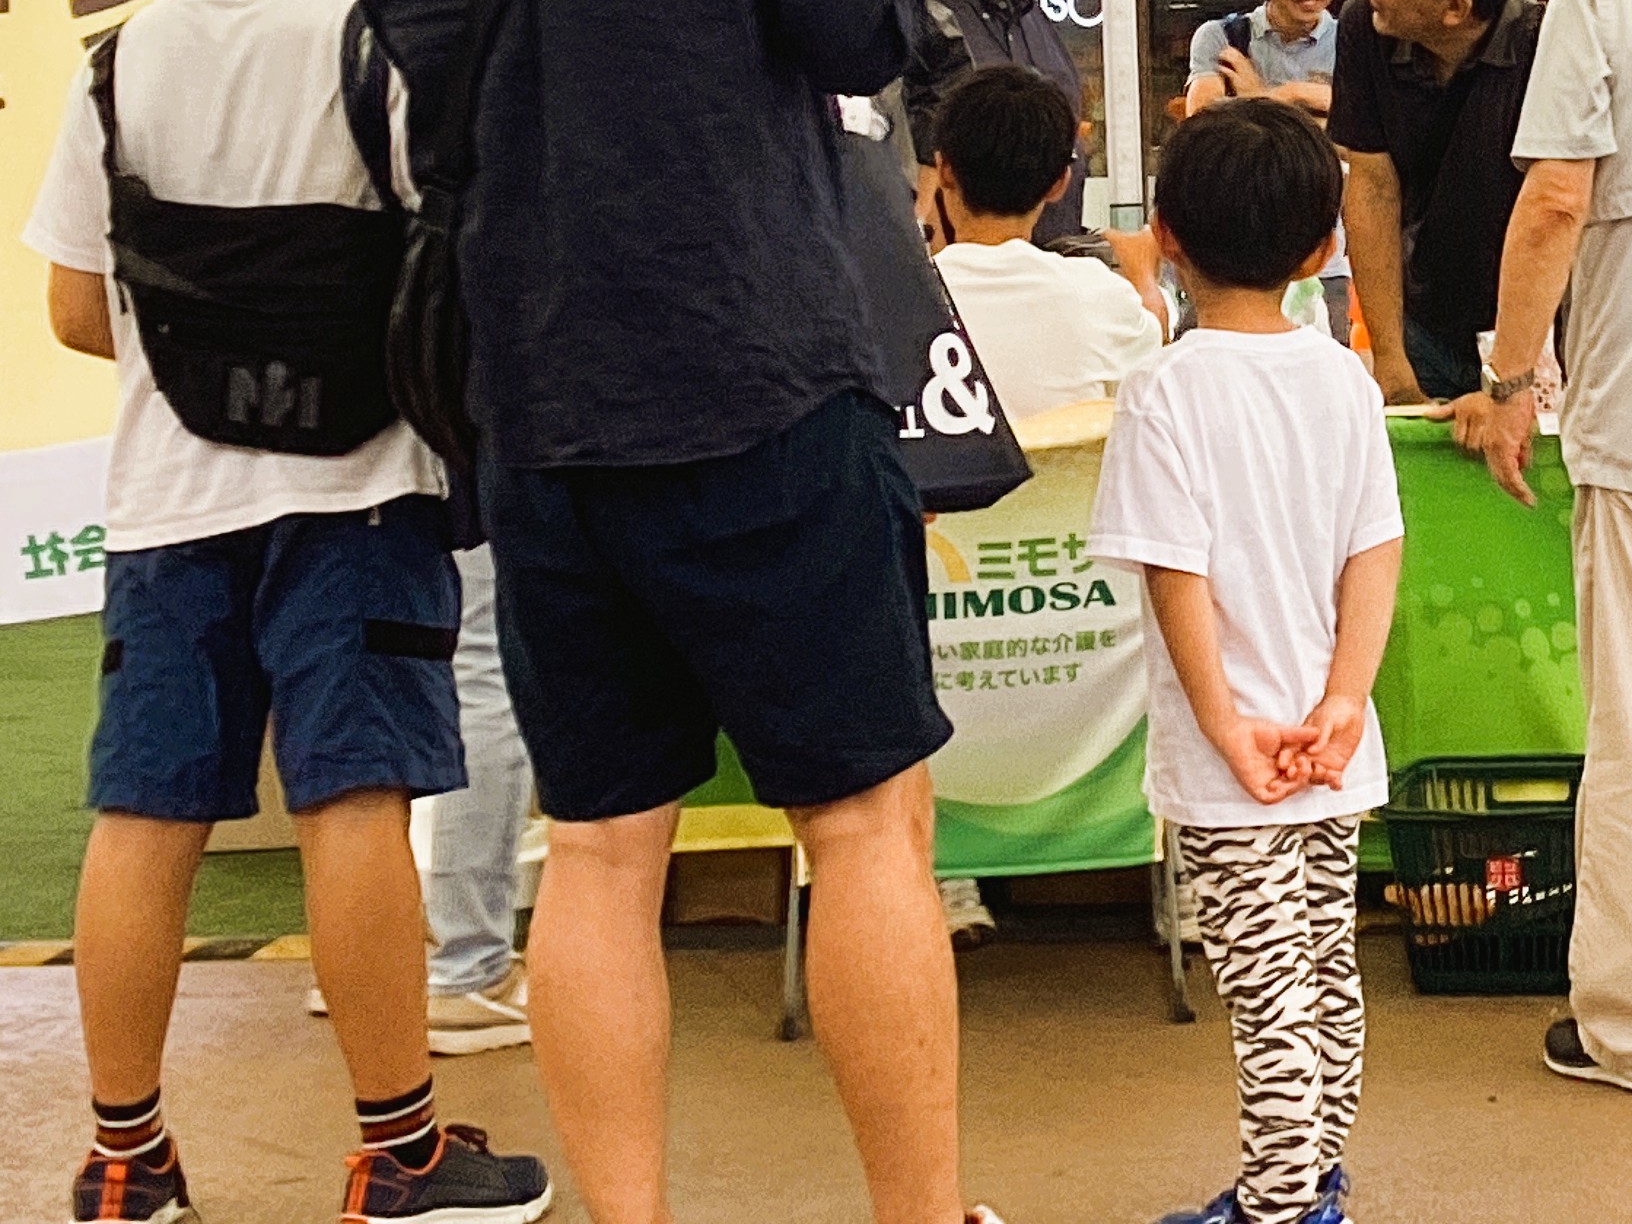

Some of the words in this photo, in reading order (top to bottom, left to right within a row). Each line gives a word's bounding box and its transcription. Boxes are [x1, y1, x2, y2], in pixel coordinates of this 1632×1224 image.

[932, 629, 1116, 661] い家庭的な介護を
